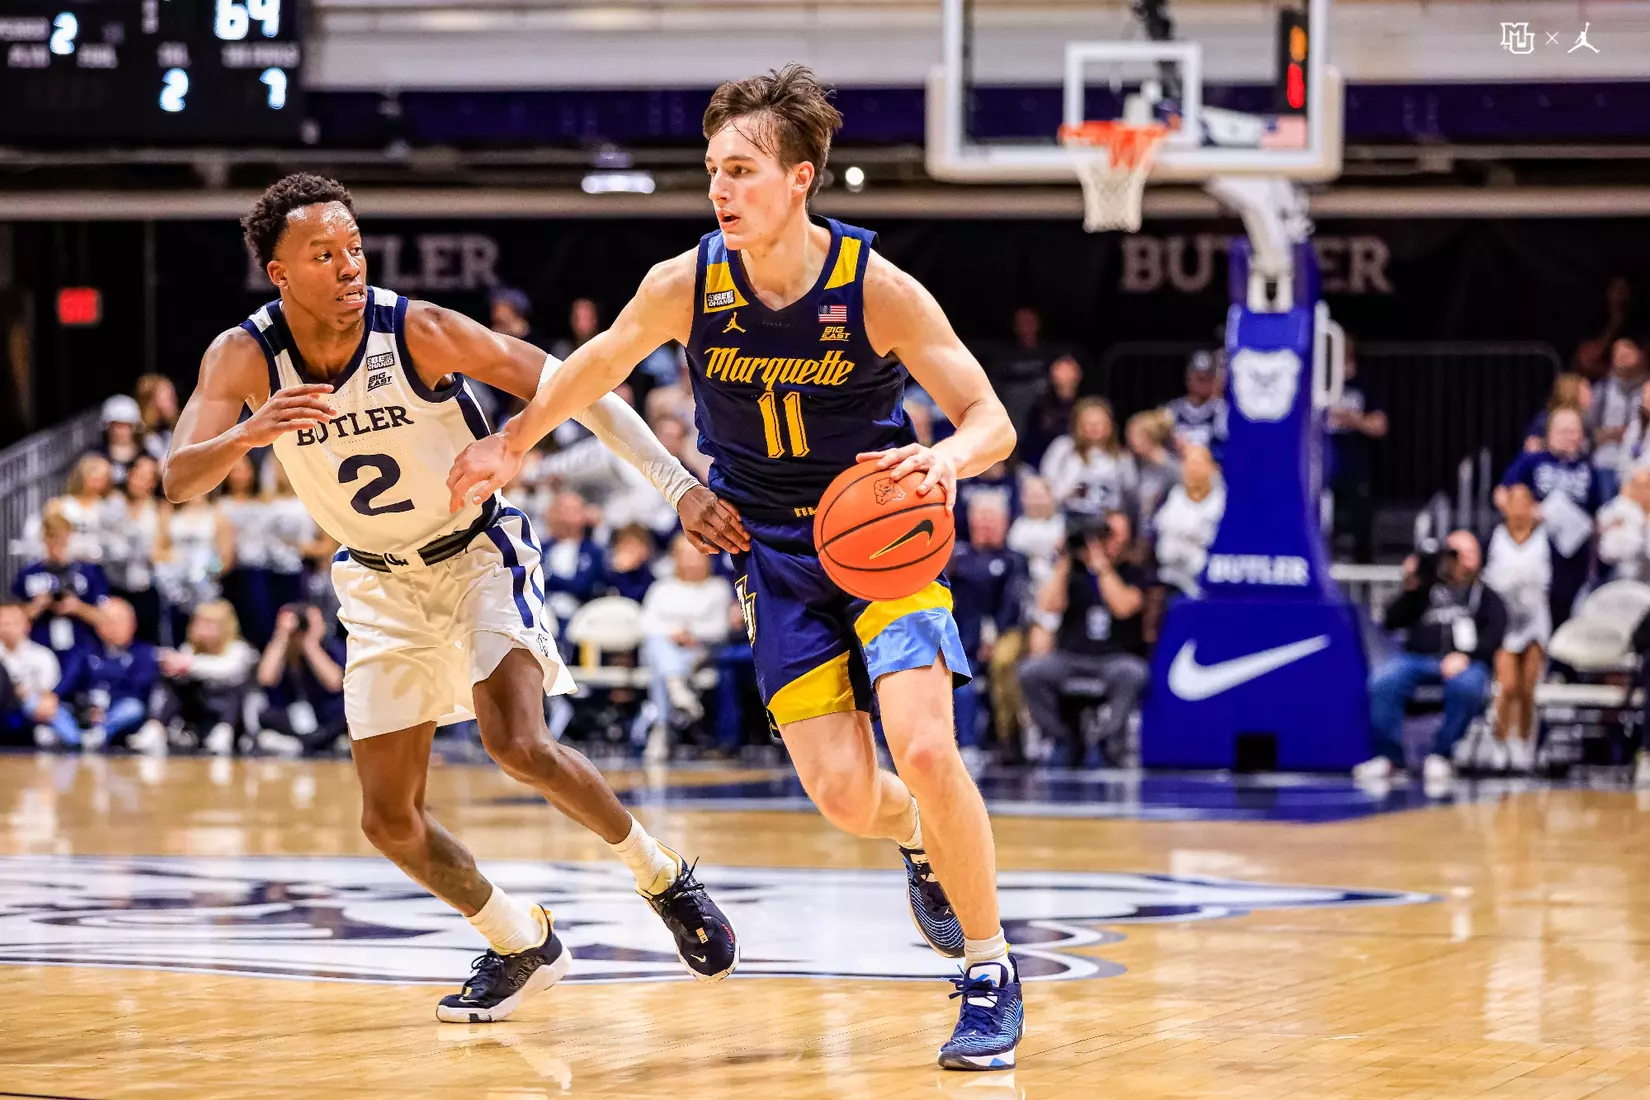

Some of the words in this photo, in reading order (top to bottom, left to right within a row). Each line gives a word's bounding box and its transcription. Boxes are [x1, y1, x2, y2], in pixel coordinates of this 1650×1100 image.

[50, 12, 78, 55] 2
[159, 67, 189, 112] 2
[1119, 234, 1394, 294] BUER
[821, 332, 851, 340] EAST
[367, 375, 393, 389] EAST
[370, 371, 386, 381] BIG
[704, 347, 855, 391] Marquette
[297, 405, 414, 446] BUTLER
[757, 391, 810, 459] 11
[338, 453, 415, 516] 2
